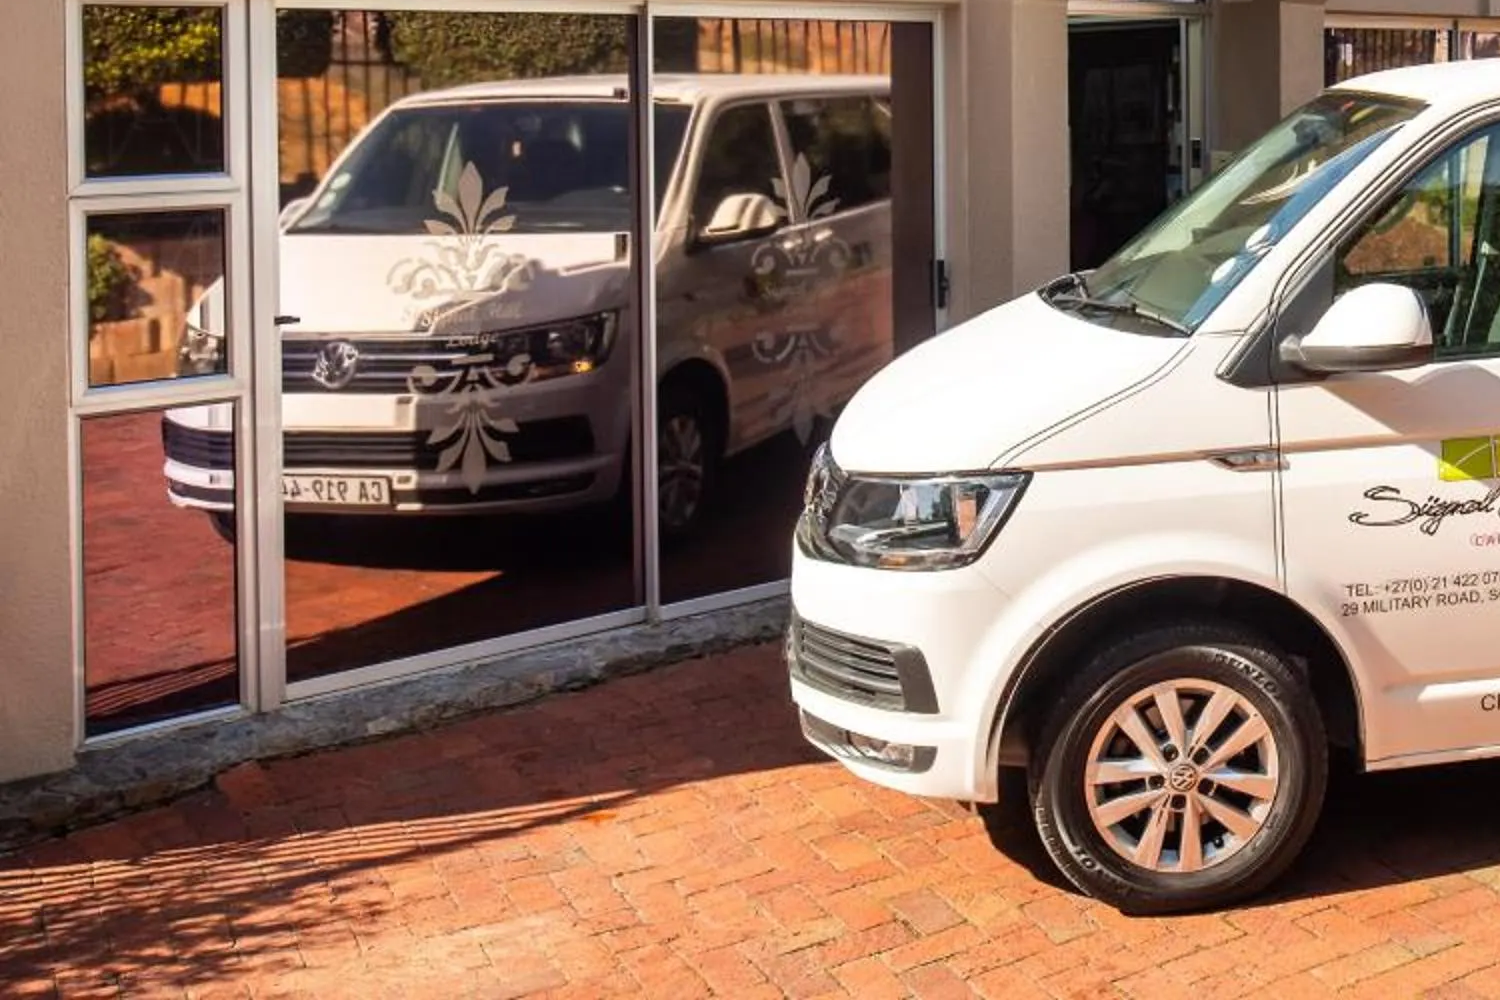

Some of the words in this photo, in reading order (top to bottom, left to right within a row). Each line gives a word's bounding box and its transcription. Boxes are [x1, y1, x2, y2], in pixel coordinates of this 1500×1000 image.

[1431, 577, 1447, 590] 21
[1453, 573, 1479, 587] 422
[1341, 603, 1359, 617] 29
[1363, 595, 1431, 614] MILITARY
